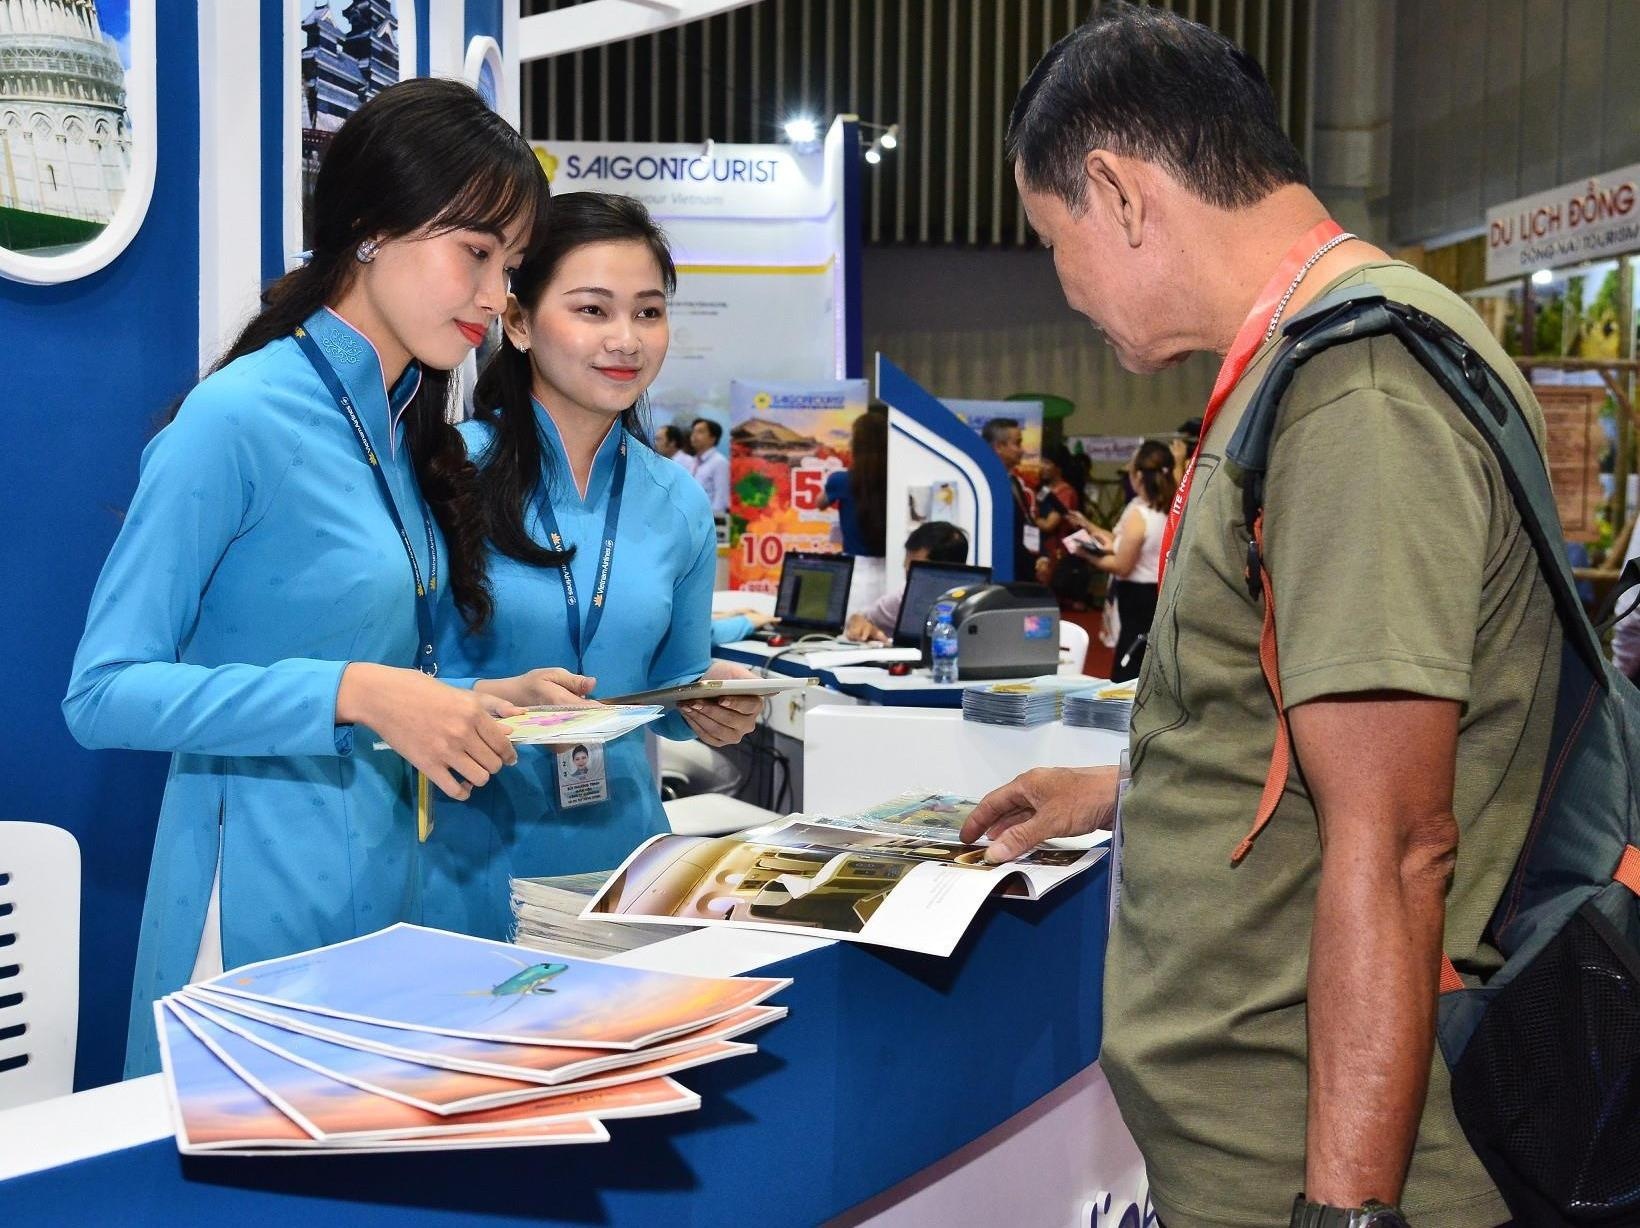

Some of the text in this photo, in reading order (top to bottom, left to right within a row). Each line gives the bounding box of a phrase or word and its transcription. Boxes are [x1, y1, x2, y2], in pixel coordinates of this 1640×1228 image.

[566, 156, 778, 183] SAIGONTOURIST
[1490, 218, 1513, 248] DU
[1172, 496, 1184, 515] ITE
[743, 535, 783, 565] 10
